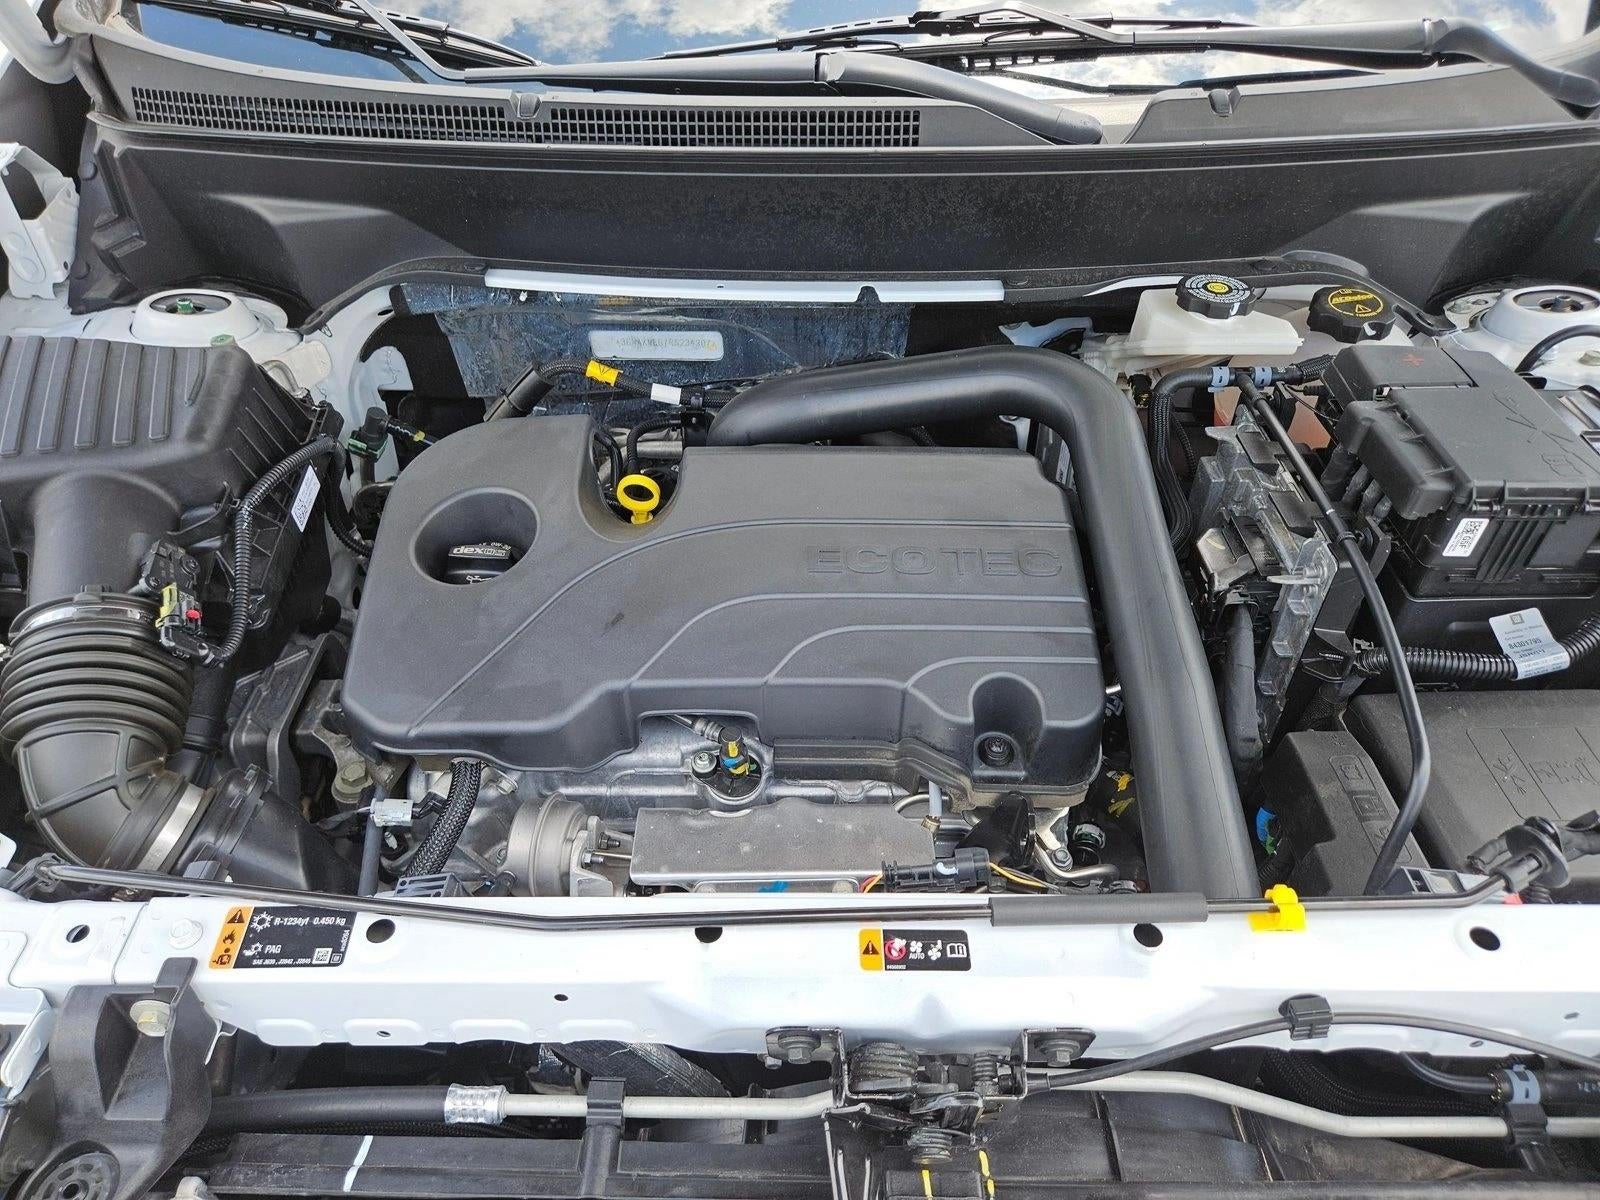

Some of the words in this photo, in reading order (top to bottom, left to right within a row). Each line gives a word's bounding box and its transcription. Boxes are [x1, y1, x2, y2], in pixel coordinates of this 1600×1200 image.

[808, 546, 1063, 577] ECOTEC
[313, 916, 335, 926] 0.450
[335, 916, 347, 927] kg
[264, 944, 282, 954] PAG
[908, 952, 925, 960] AUTO
